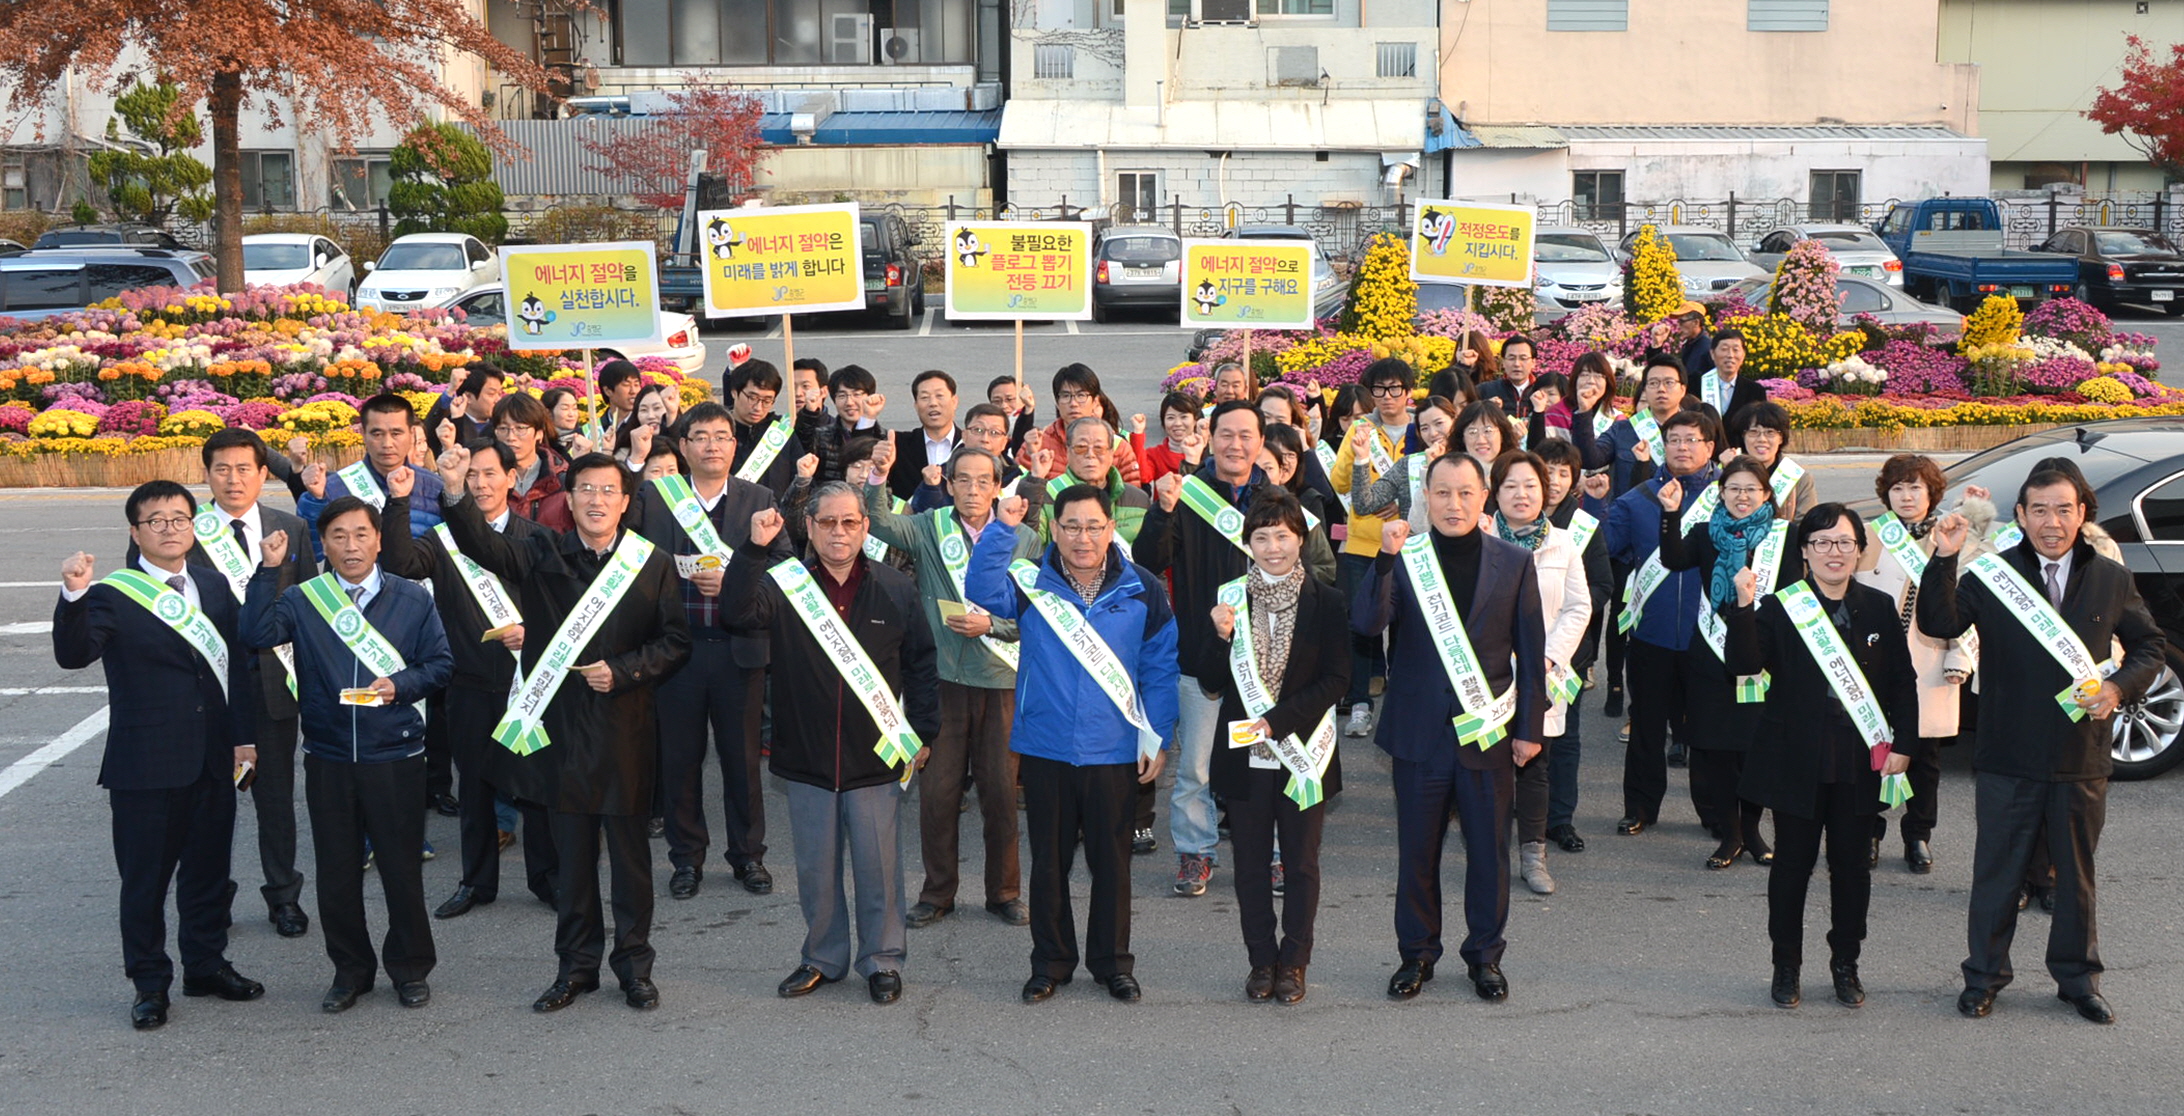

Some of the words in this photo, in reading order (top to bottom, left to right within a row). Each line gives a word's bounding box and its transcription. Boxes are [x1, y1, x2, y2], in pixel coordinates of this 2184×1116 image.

[747, 234, 793, 255] 에너지
[797, 231, 844, 253] 절약은
[1010, 234, 1072, 252] 불필요한
[1459, 222, 1520, 241] 적정온도를
[990, 254, 1037, 271] 플로그
[1041, 253, 1072, 272] 뽑기
[1200, 255, 1244, 274] 에너지
[1247, 254, 1299, 273] 절약으로
[1465, 242, 1518, 260] 지킵시다.
[534, 263, 585, 285] 에너지
[590, 262, 638, 283] 절약을
[723, 260, 767, 281] 미래를
[770, 260, 798, 279] 밝게
[802, 257, 846, 277] 합니다
[1006, 274, 1037, 291] 전등
[1041, 273, 1072, 291] 끄기
[559, 287, 640, 310] 실천합시다.
[1218, 277, 1256, 296] 지구를
[1260, 277, 1299, 295] 구해요
[353, 475, 374, 498] 생활속
[698, 527, 718, 553] 생활속
[215, 541, 245, 578] 내가뽑은
[600, 569, 626, 600] 생활속
[477, 578, 510, 620] 에너지절약
[1413, 551, 1438, 593] 내가뽑은
[1427, 592, 1456, 634] 전기코드
[1443, 634, 1473, 675] 다음세대
[1992, 570, 2036, 612] 에너지절약
[2031, 609, 2061, 641] 미래로
[566, 595, 606, 644] 에너지절약
[191, 620, 220, 658] 내가뽑은
[801, 590, 826, 621] 생활속
[819, 618, 858, 665] 에너지절약
[851, 663, 878, 694] 미래로
[1044, 594, 1078, 633] 내가뽑은
[1070, 626, 1106, 667] 전기코드
[1100, 661, 1130, 699] 다음세대
[361, 637, 397, 675] 내가뽑은
[547, 640, 573, 672] 미래로
[1235, 660, 1262, 703] 전기코드
[1811, 625, 1837, 656] 생활속
[1829, 655, 1865, 704] 에너지절약
[1857, 701, 1879, 731] 미래로
